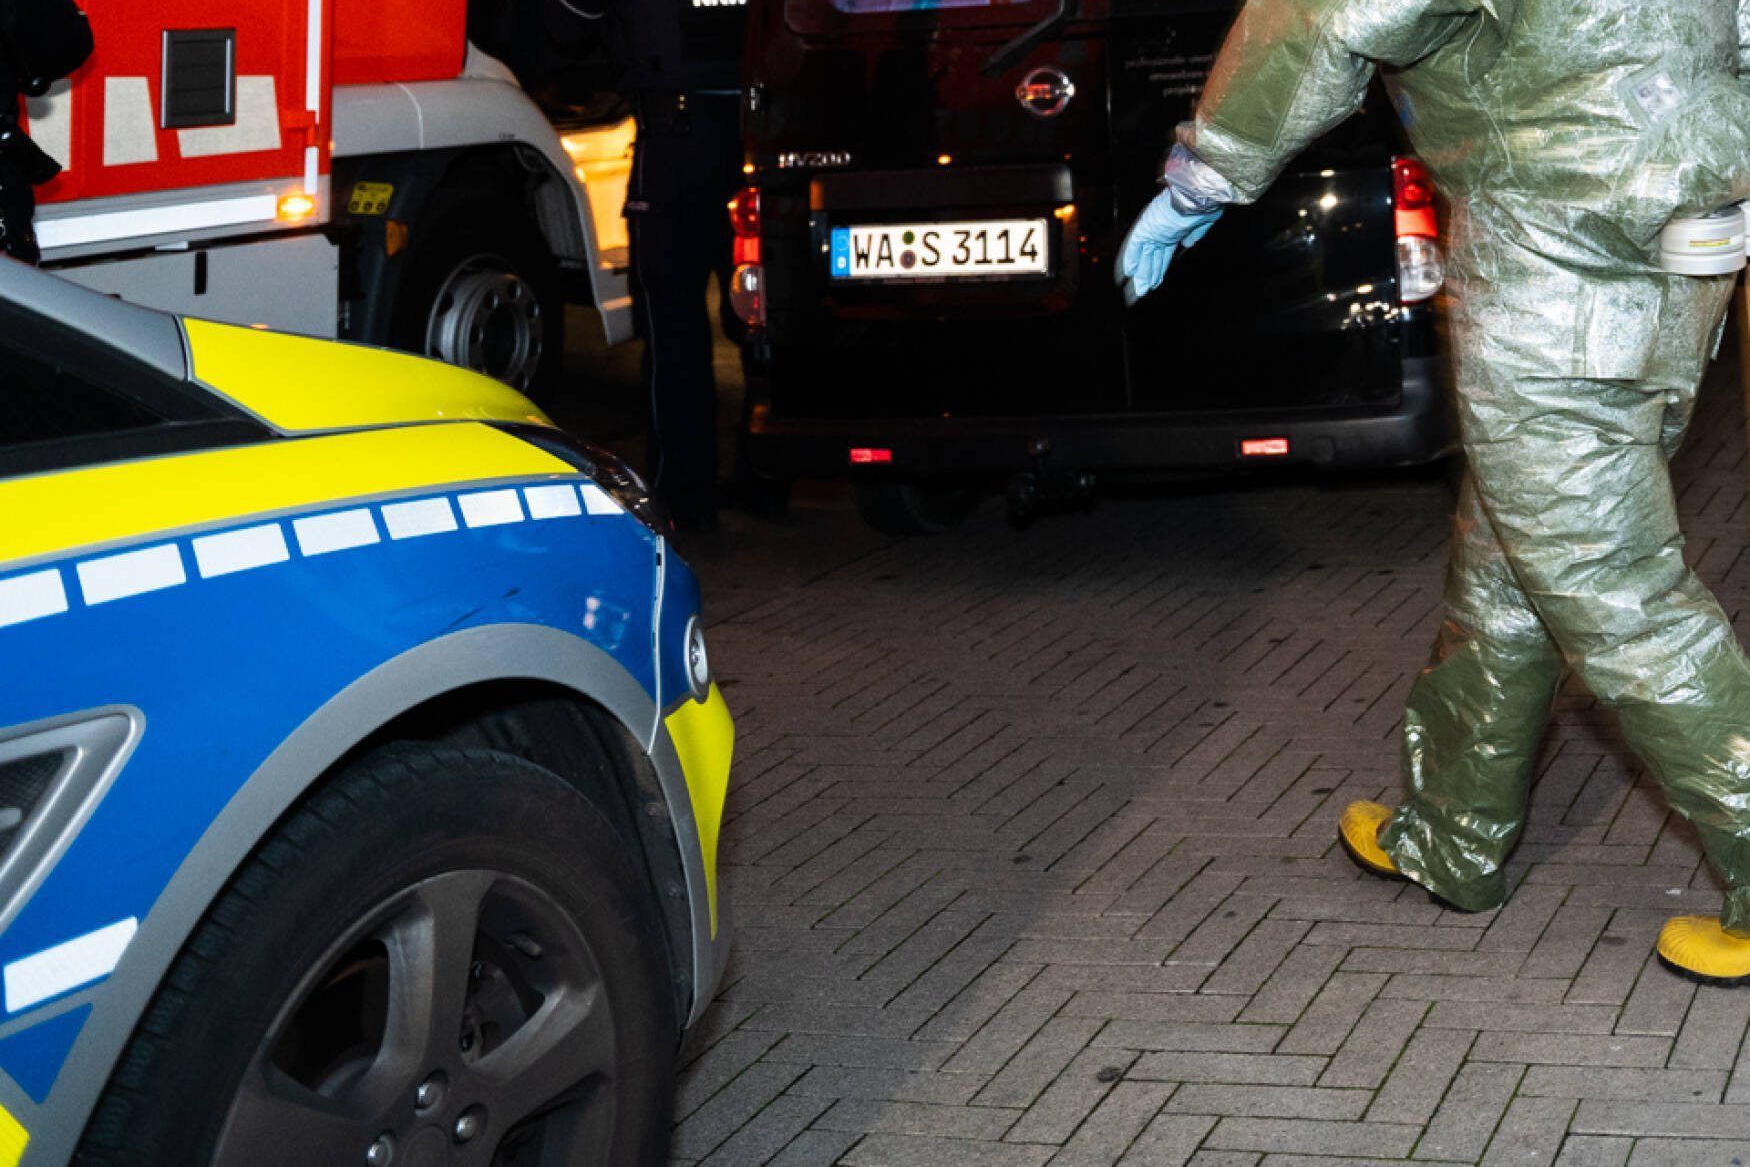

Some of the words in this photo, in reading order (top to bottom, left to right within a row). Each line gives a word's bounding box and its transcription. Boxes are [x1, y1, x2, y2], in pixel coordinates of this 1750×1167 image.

[853, 233, 895, 268] WA
[920, 230, 941, 266] S
[951, 227, 1039, 265] 3114
